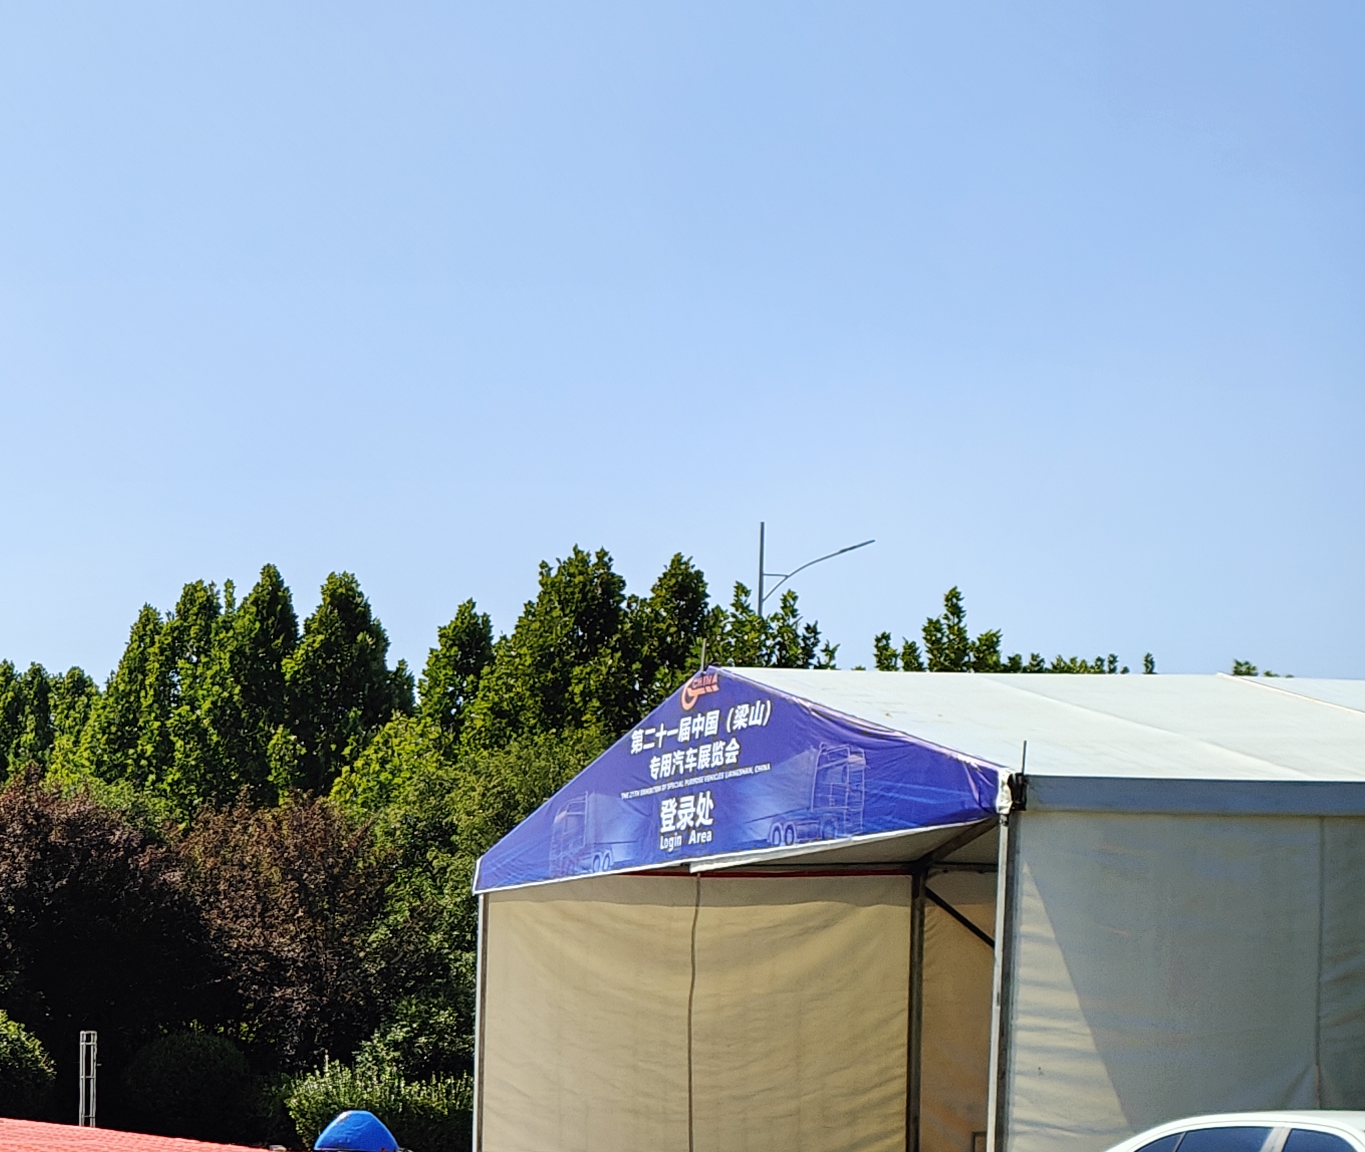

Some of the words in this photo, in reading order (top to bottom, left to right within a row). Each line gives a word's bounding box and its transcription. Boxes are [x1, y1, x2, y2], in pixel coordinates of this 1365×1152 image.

[649, 738, 741, 780] 专用汽车展览会
[660, 791, 714, 833] 登录处
[660, 832, 682, 852] Login
[688, 829, 713, 845] Area
